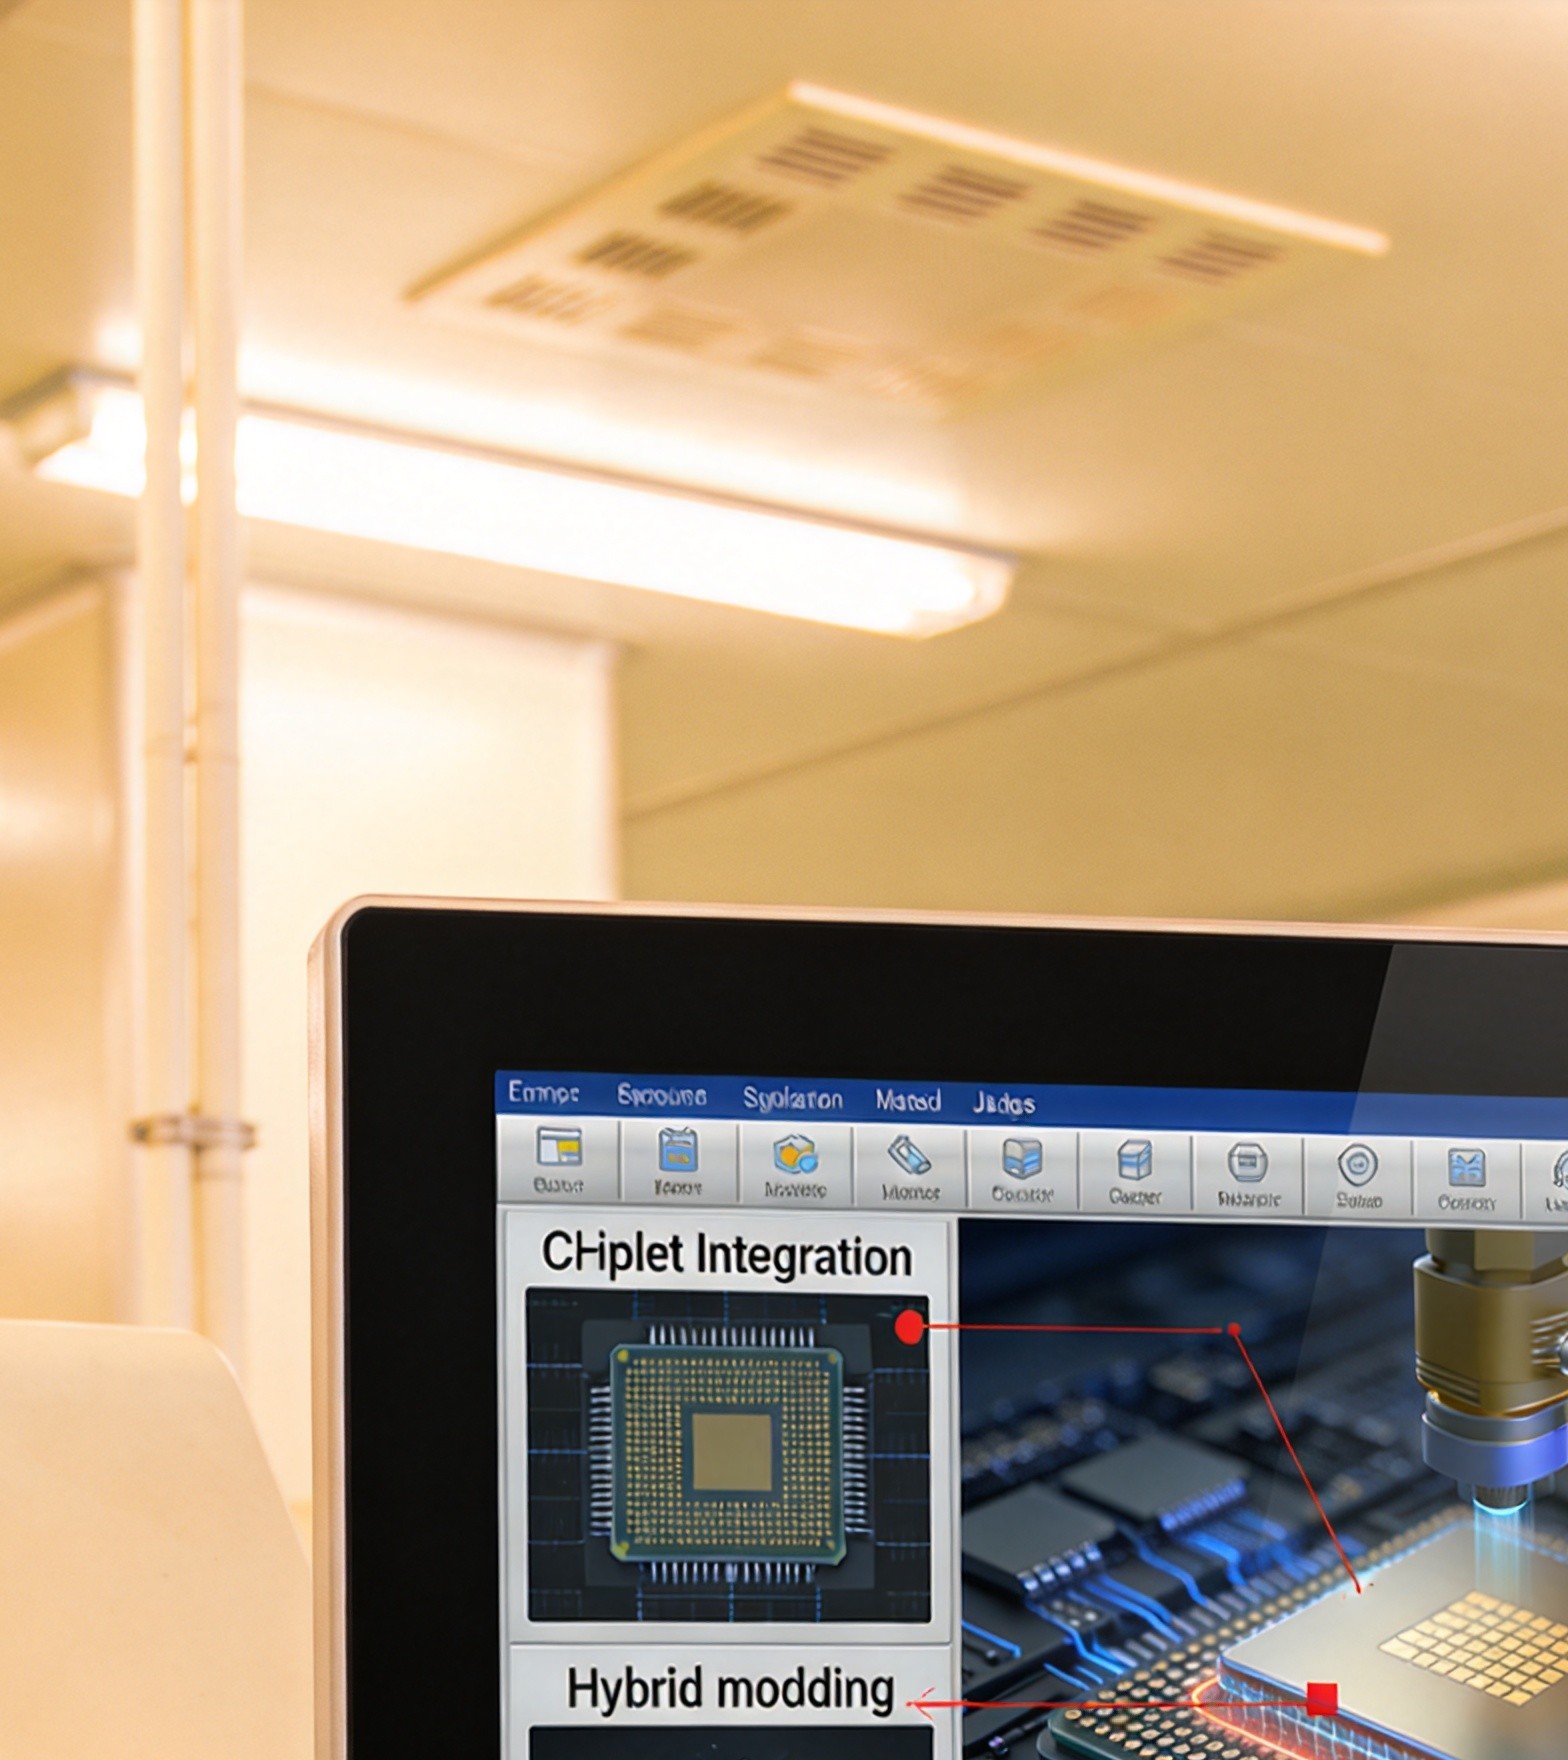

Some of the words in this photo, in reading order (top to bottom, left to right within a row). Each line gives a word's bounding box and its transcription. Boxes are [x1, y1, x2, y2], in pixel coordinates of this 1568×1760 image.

[697, 1231, 913, 1284] Integration
[567, 1664, 703, 1718] Hybrid
[717, 1664, 895, 1718] modding
